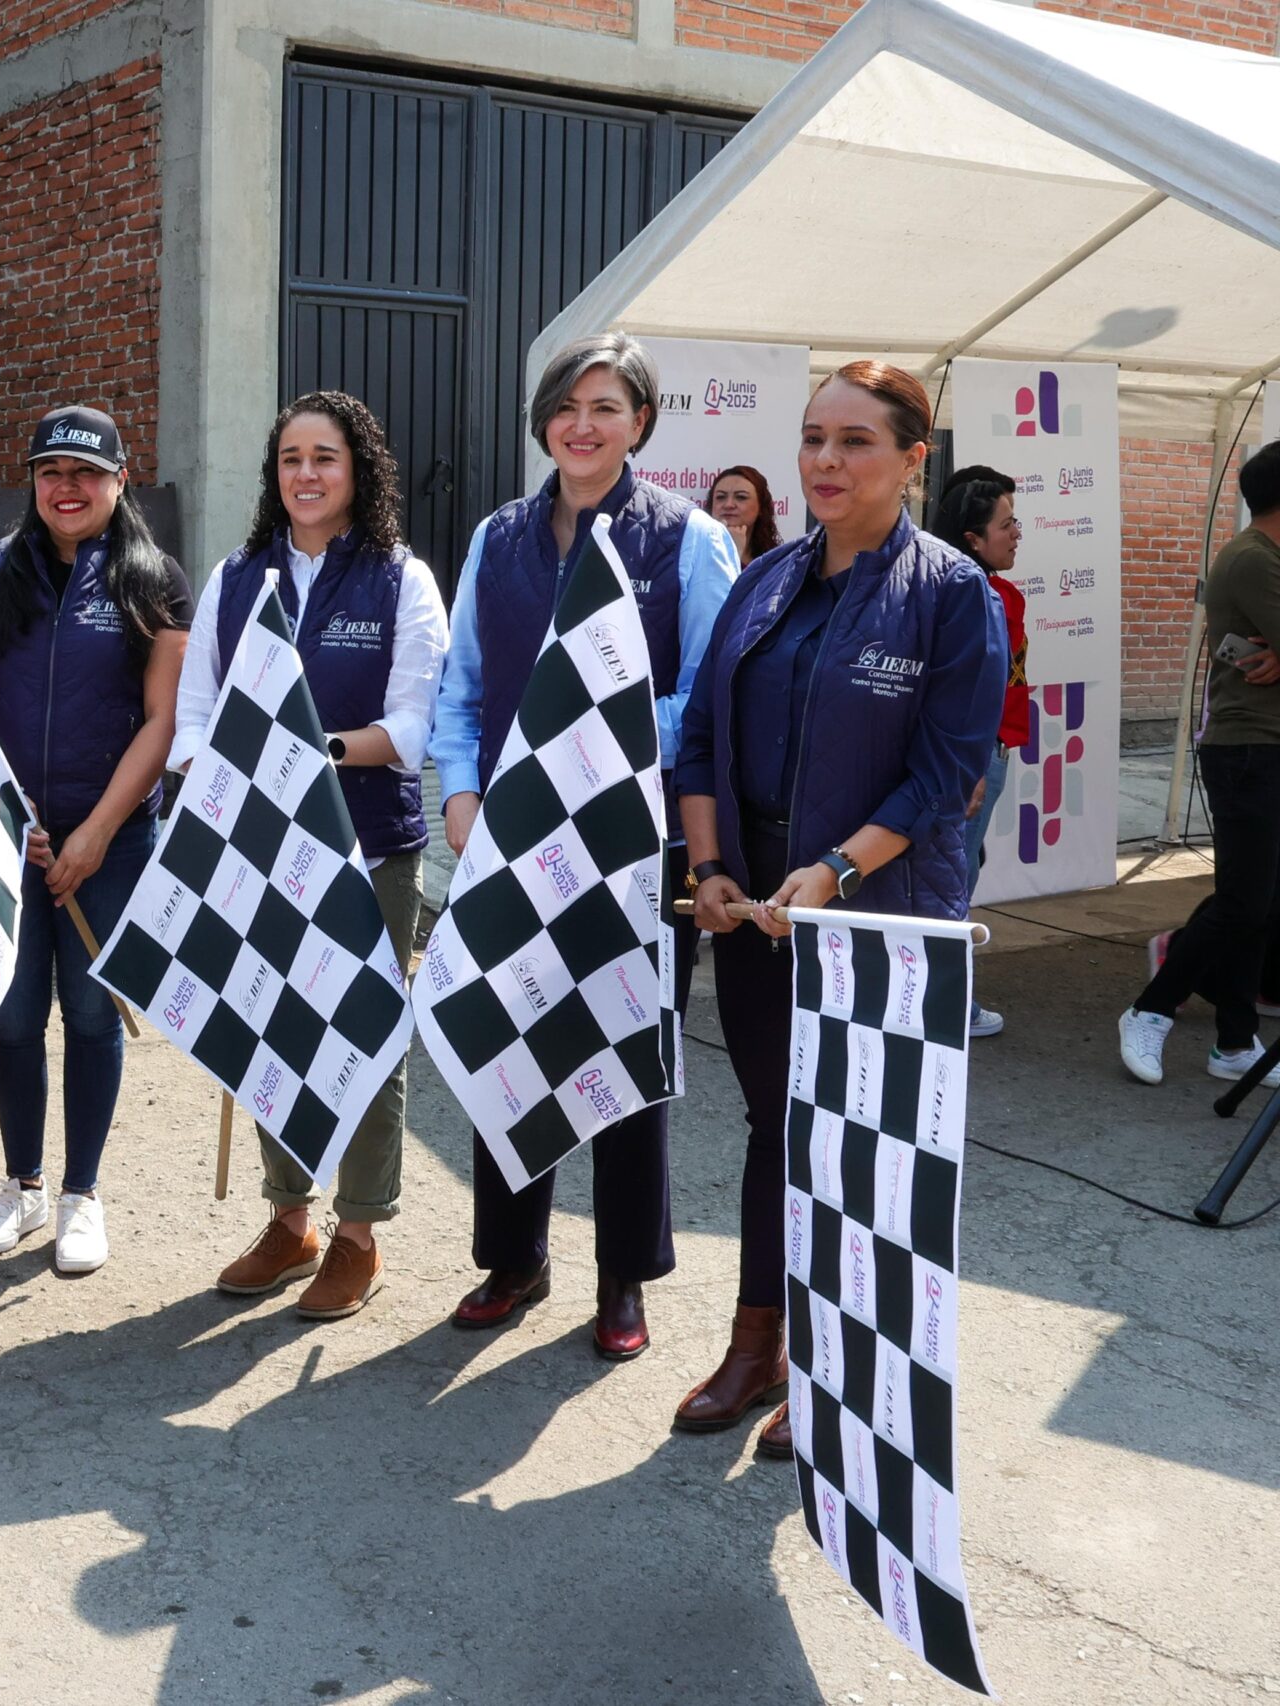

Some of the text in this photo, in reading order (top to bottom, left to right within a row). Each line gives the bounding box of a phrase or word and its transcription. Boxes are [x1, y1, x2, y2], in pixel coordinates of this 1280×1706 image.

[659, 393, 692, 410] EEM
[710, 380, 757, 402] 1 Junio
[726, 395, 756, 409] 2025
[68, 429, 102, 446] IEEM
[680, 467, 697, 489] de
[1026, 474, 1043, 483] vota,
[1026, 483, 1044, 495] justo
[1062, 466, 1093, 485] 1 Junio
[1073, 477, 1094, 488] 2025
[1067, 526, 1094, 537] es justo
[1064, 568, 1094, 586] 1 Junio
[1074, 578, 1094, 589] 2025
[1028, 586, 1045, 597] justo
[345, 622, 382, 634] IEEM
[1068, 627, 1094, 638] es justo
[600, 644, 628, 681] IEEM
[868, 670, 904, 682] Consejera
[881, 656, 924, 676] IEEM
[280, 742, 301, 779] IEEM
[209, 764, 225, 794] Junio
[215, 770, 232, 799] 2025
[291, 840, 309, 869] Junio
[299, 847, 317, 876] 2025
[552, 868, 572, 899] 2025
[561, 860, 580, 891] Junio
[163, 885, 183, 919] IEEM
[249, 963, 268, 999] IEEM
[428, 959, 447, 992] 2025
[436, 952, 454, 986] Junio
[171, 976, 190, 1003] Junio
[179, 981, 197, 1010] 2025
[523, 976, 548, 1010] IEEM
[260, 1061, 276, 1089] Junio
[266, 1068, 282, 1096] 2025
[337, 1052, 359, 1088] IEEM
[590, 1091, 613, 1120] 2025
[600, 1085, 622, 1115] Junio
